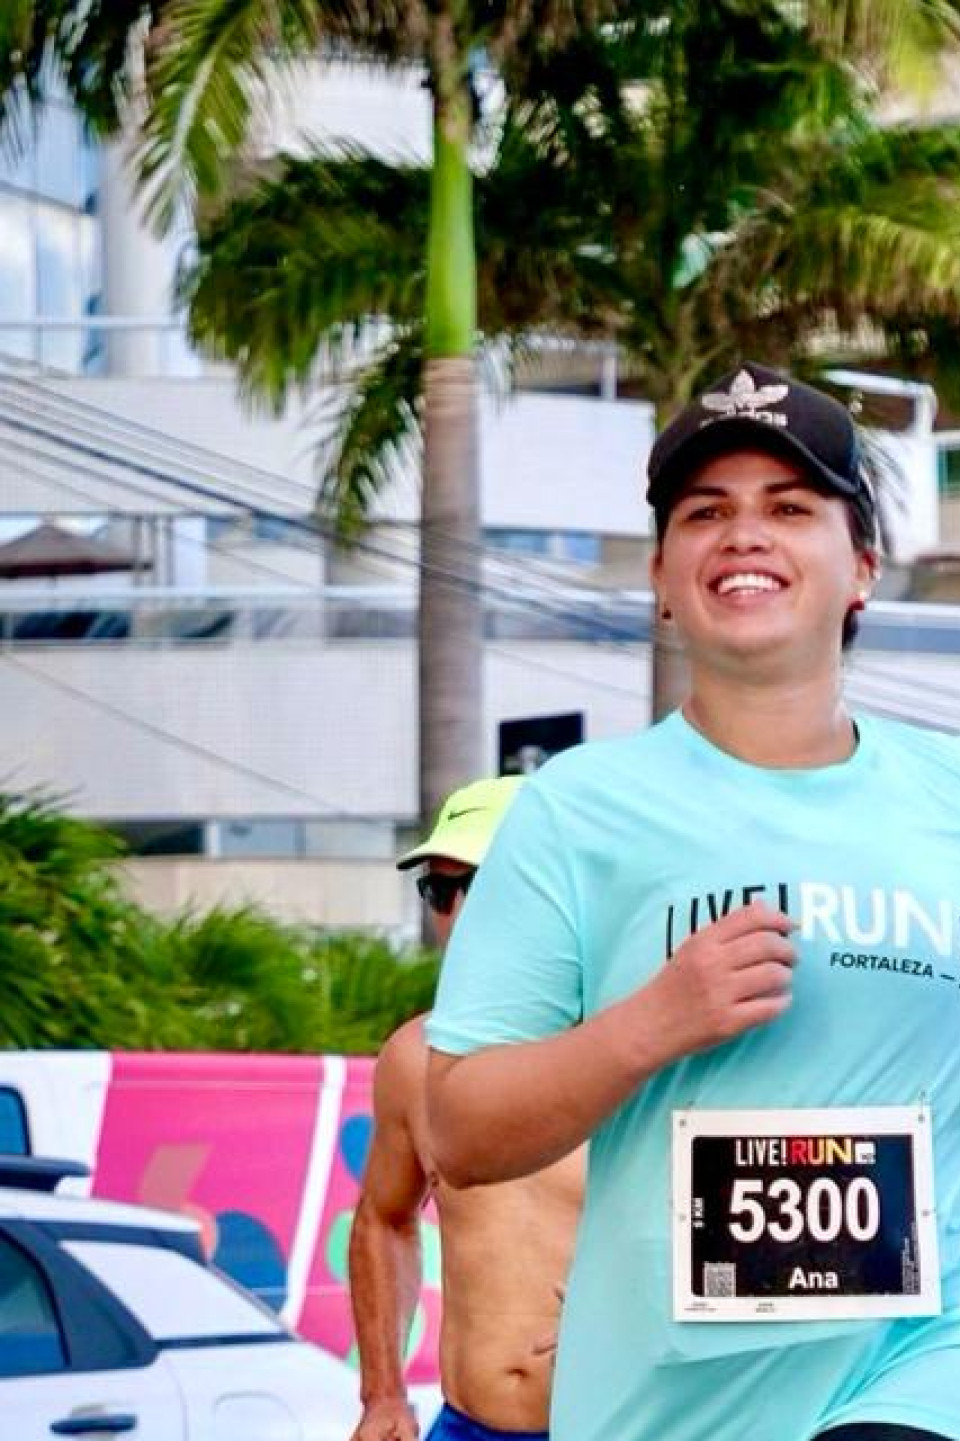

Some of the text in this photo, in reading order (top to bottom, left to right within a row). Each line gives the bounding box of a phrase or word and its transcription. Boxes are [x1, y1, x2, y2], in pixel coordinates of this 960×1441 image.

[830, 952, 933, 977] FORTALEZA
[728, 1176, 880, 1243] 5300
[789, 1267, 838, 1289] Ana
